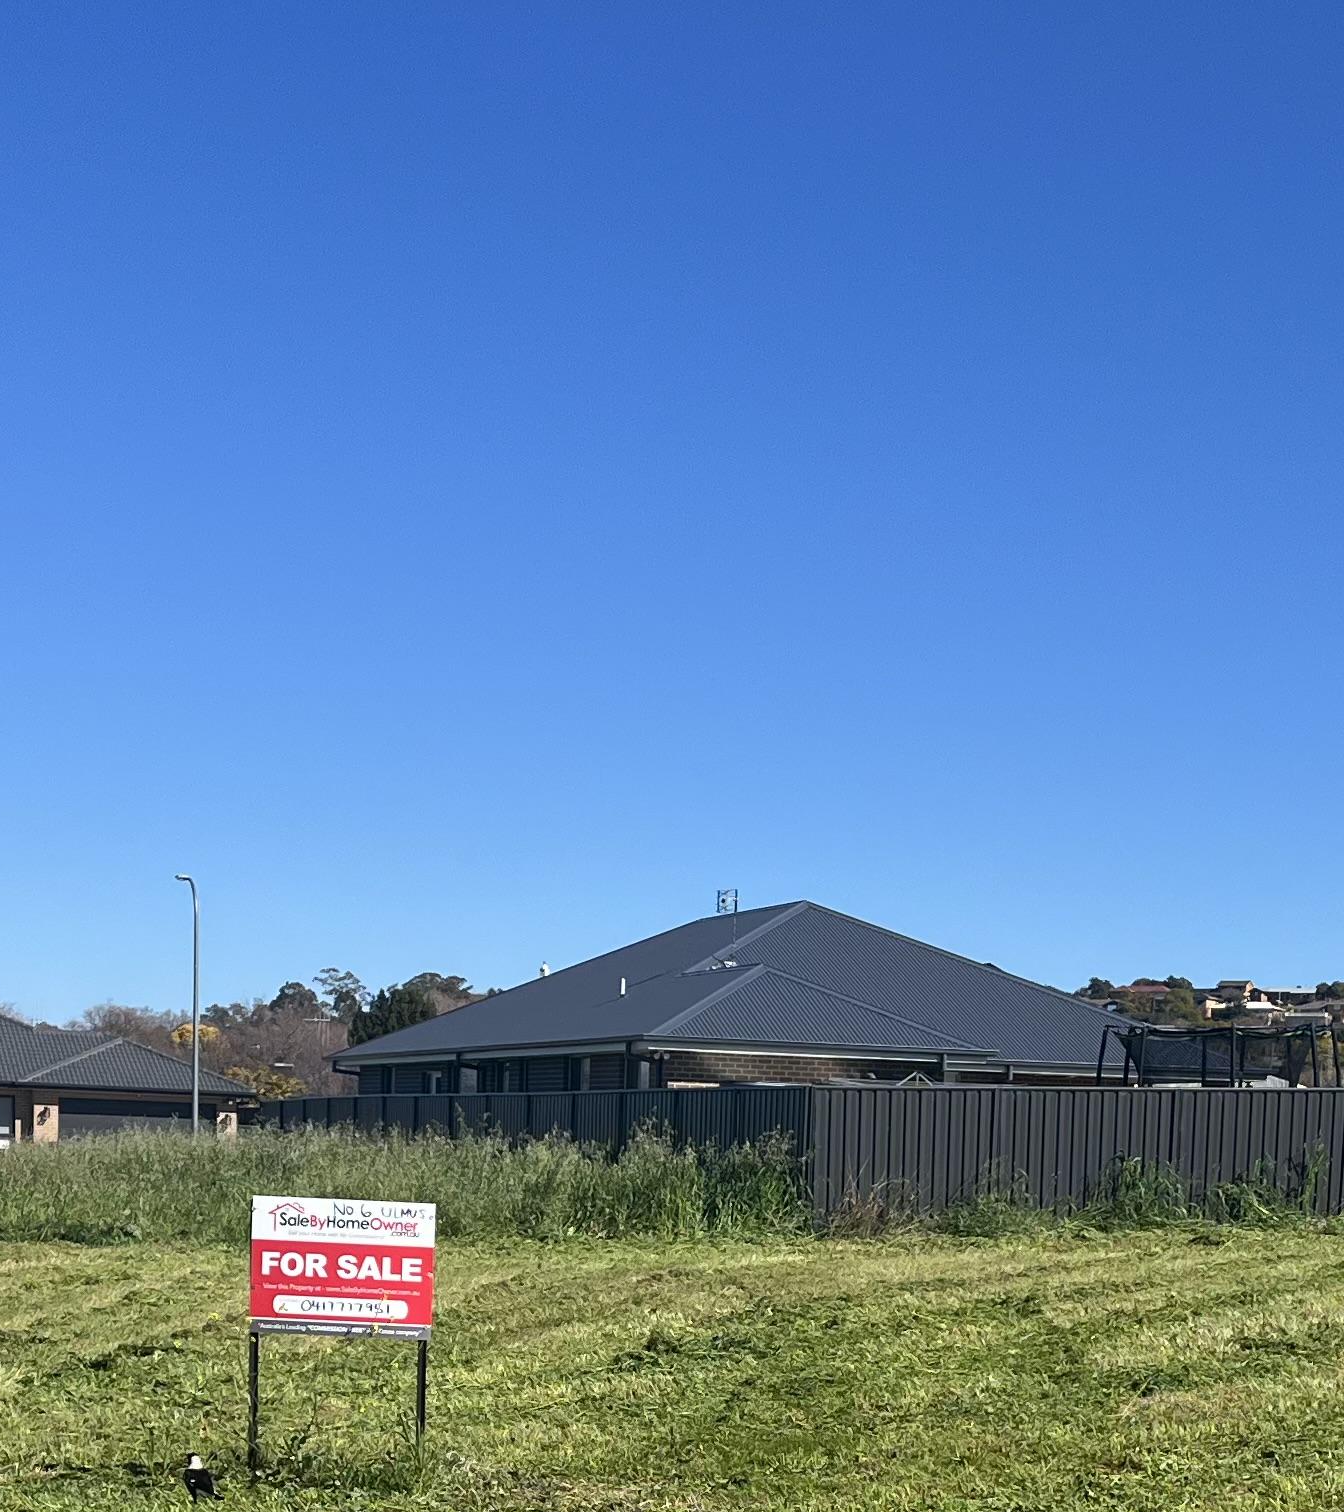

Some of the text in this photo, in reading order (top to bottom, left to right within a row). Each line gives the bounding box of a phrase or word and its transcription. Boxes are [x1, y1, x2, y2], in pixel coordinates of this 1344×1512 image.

[279, 1211, 418, 1232] SaleByHomeOwner
[360, 1204, 372, 1218] 6
[261, 1251, 423, 1283] FOR SALE
